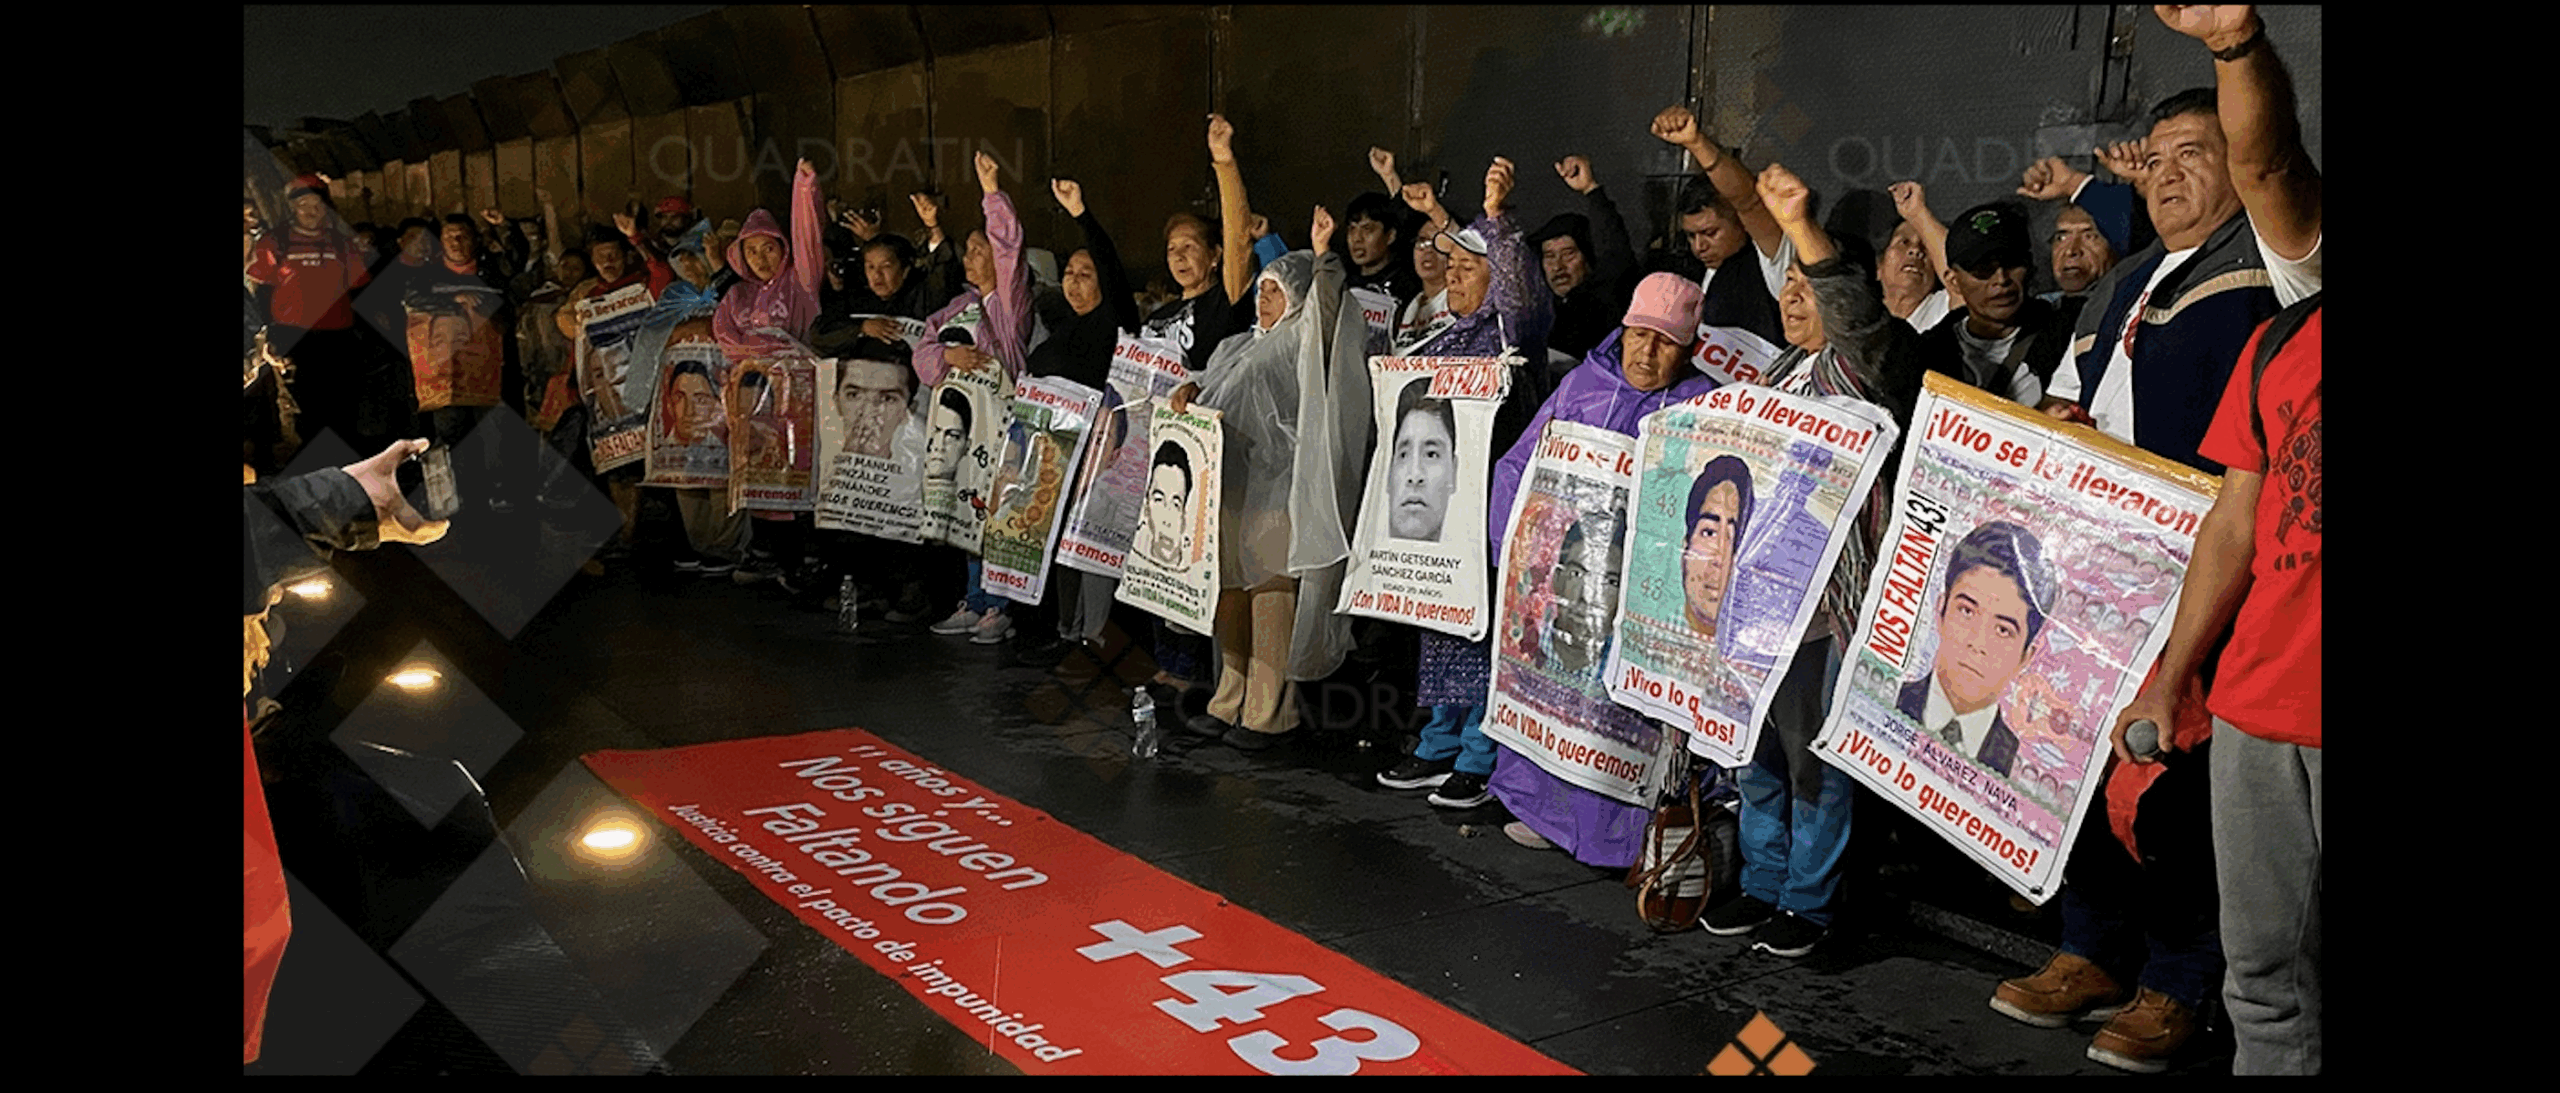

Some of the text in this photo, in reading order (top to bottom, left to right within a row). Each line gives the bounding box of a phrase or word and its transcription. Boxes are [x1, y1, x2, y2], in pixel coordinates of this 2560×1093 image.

[1363, 309, 1387, 324] on!
[1709, 391, 1731, 409] se
[1736, 389, 1755, 414] lo
[1758, 397, 1872, 454] llevaron!
[1927, 407, 2199, 537] ¡Vivo se lo llevaron
[1372, 564, 1453, 585] SÁNCHEZ GARCÍA
[1400, 552, 1461, 569] GETSEMANY
[1885, 524, 1936, 616] FALTAN
[1376, 592, 1401, 614] VIDA
[1403, 597, 1413, 616] lo
[1415, 601, 1476, 626] queremos!
[1869, 607, 1911, 666] NOS
[1668, 681, 1684, 706] lo
[1496, 704, 1646, 784] ¡Con VIDA lo queremos!
[1883, 714, 1918, 747] JORGE
[1984, 780, 2018, 811] NAVA
[779, 756, 1049, 891] Nos siguen
[878, 759, 968, 797] años
[940, 796, 1013, 827] y...
[1837, 730, 2039, 874] ¡Vivo lo queremos!
[742, 802, 967, 926] Faltando
[668, 803, 1083, 1063] Justicia contra el pacto de impunidad
[1075, 918, 1421, 1076] +43
